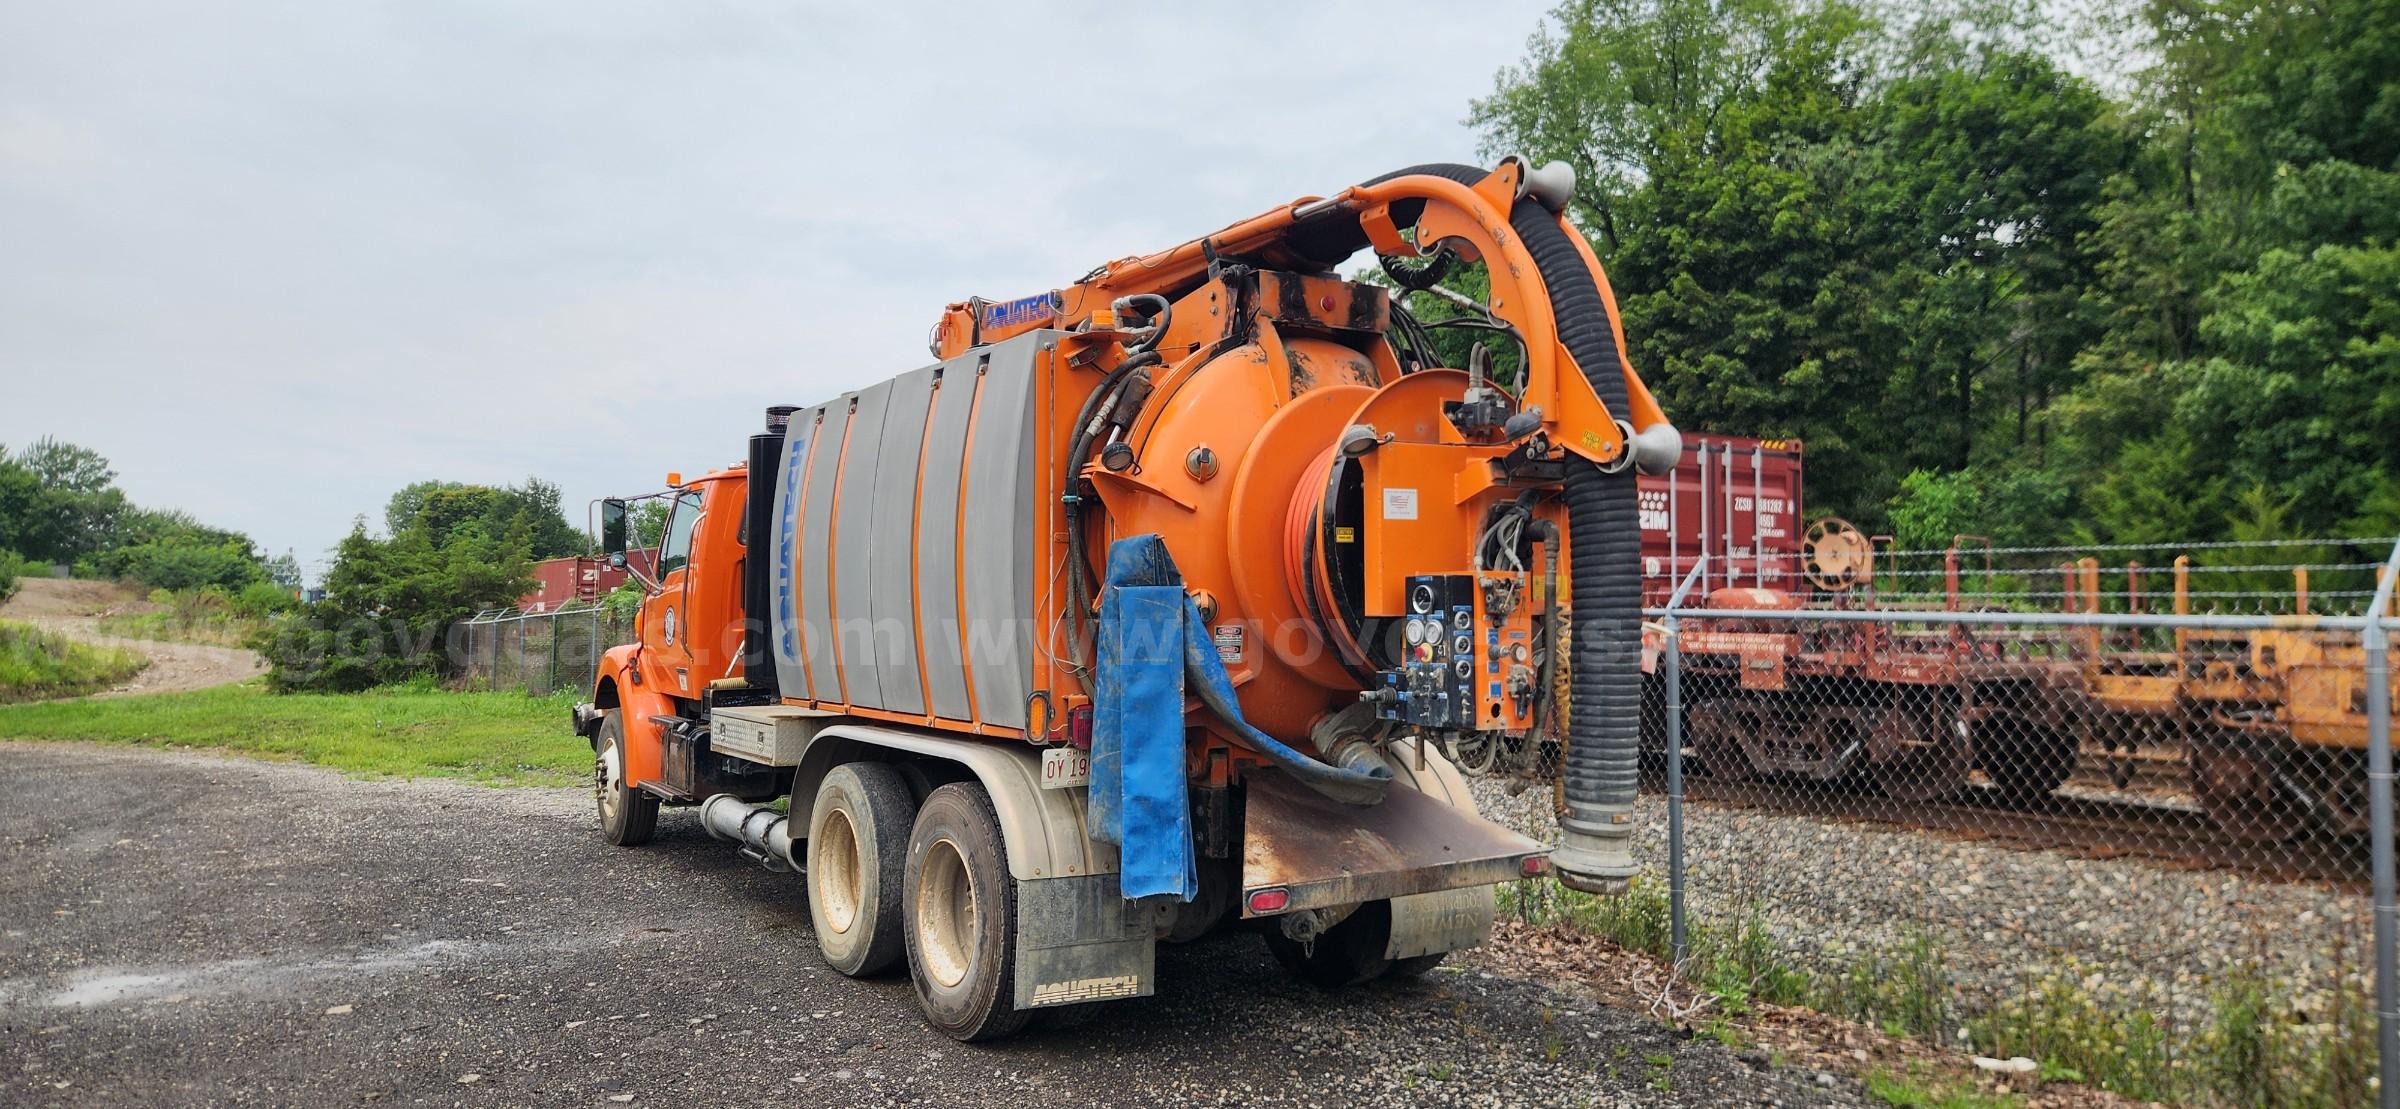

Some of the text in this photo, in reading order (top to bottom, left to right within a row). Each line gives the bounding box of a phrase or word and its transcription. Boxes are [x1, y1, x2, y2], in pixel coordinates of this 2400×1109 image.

[985, 291, 1055, 329] AQUATECH
[1640, 511, 1669, 530] ZIM
[779, 438, 806, 663] AQUATECH
[1070, 758, 1090, 777] 19
[1031, 975, 1138, 1007] AQUATECH
